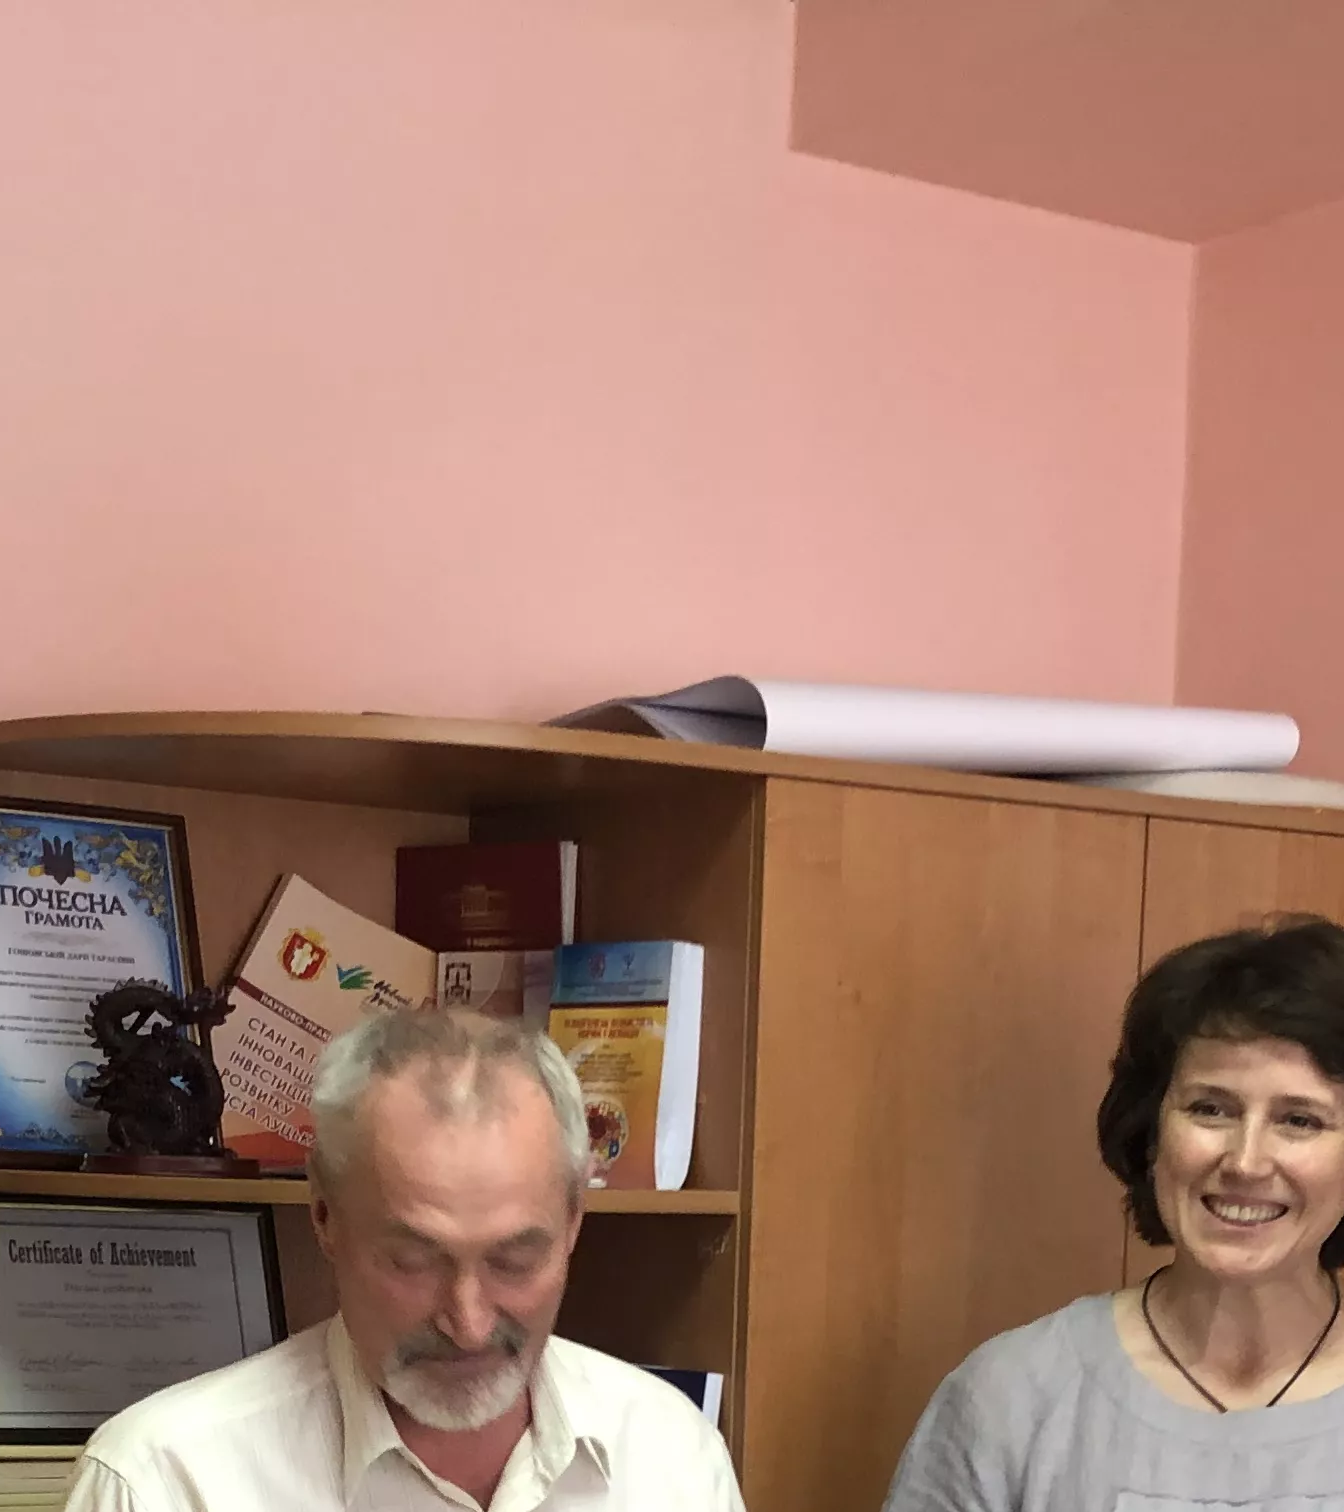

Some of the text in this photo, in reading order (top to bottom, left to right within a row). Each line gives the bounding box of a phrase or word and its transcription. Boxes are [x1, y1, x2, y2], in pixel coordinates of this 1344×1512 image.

[24, 910, 105, 931] ГРАМОТА
[248, 1017, 287, 1048] СТАН
[289, 1041, 305, 1060] ТА
[220, 1067, 293, 1115] РОЗВИТКУ
[223, 1092, 257, 1120] ІСТА
[8, 1239, 197, 1267] Certificate of Achievement
